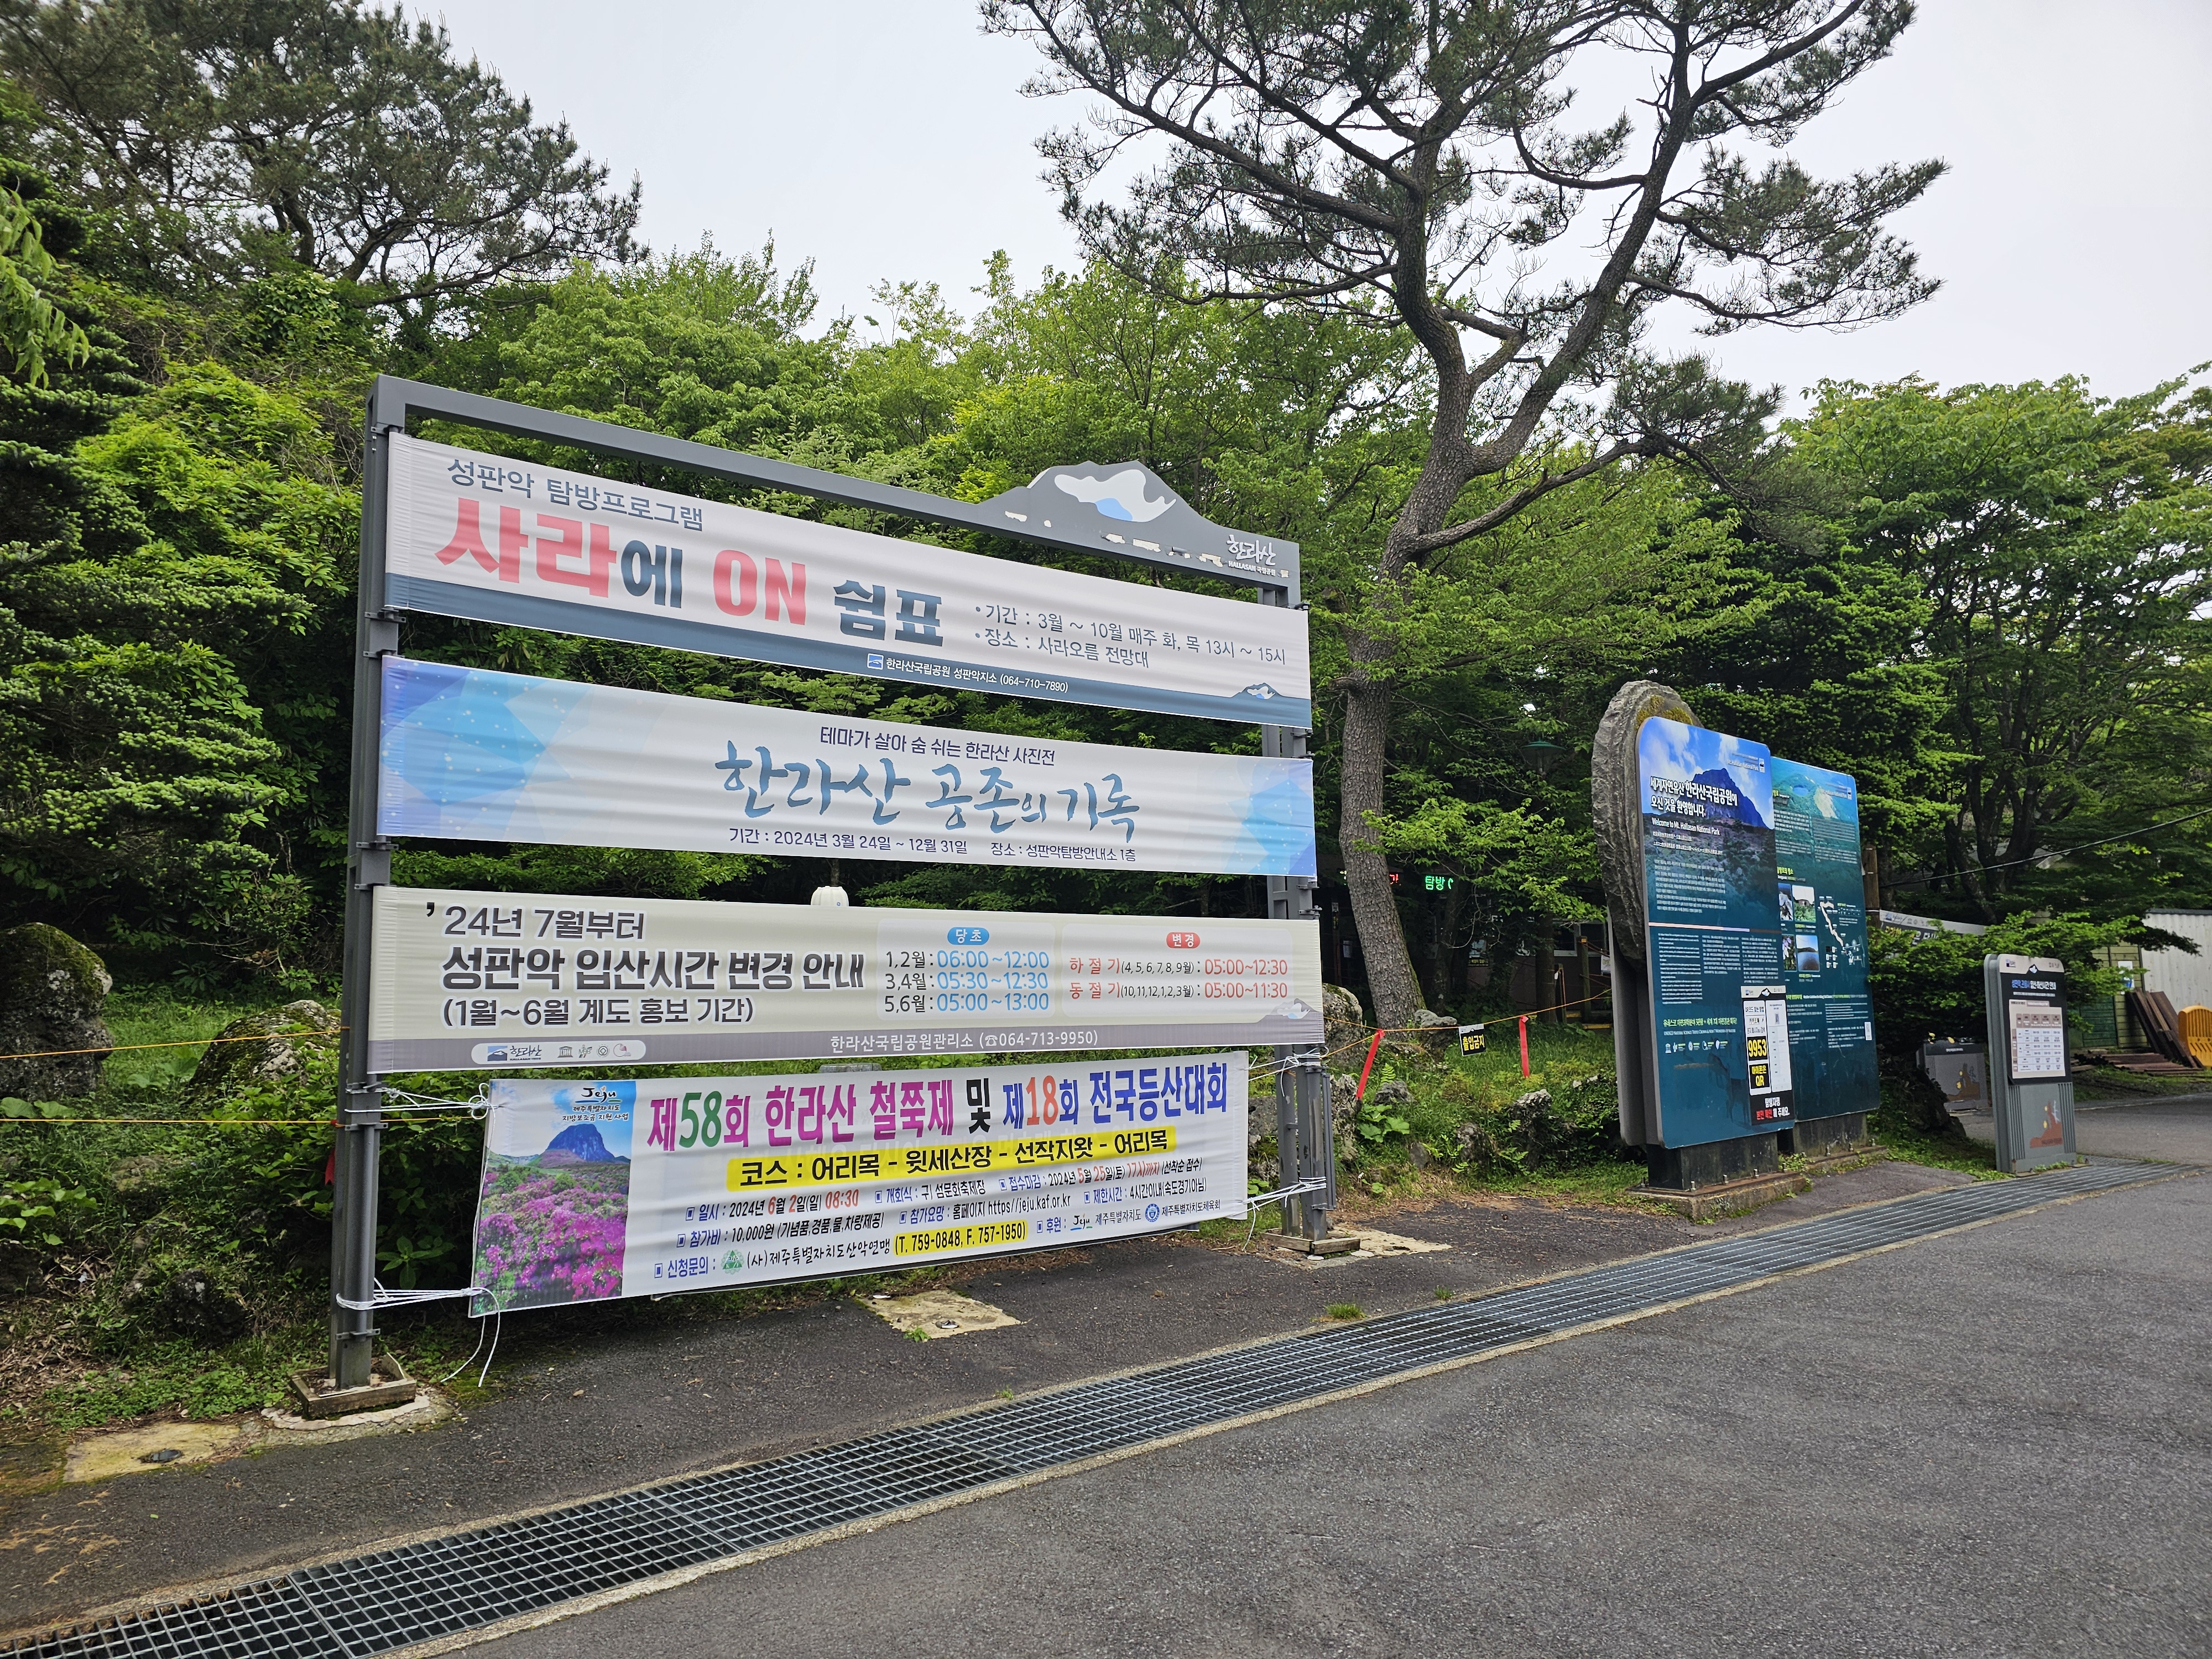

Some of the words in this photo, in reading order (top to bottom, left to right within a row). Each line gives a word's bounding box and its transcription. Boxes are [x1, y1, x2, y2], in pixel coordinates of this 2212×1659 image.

[447, 458, 535, 499] 성판악
[547, 478, 703, 532] 탐방프로그램
[1227, 534, 1276, 566] 한라산
[435, 497, 684, 609] 사라에
[713, 549, 806, 625] ON
[833, 580, 943, 647] 쉼표
[1228, 560, 1256, 572] HALLASAN
[985, 628, 1018, 648] 장소
[1038, 637, 1099, 661] 사라오름
[1105, 646, 1149, 668] 전망대
[986, 605, 1018, 625] 기간
[1039, 613, 1063, 633] 3월
[1091, 622, 1122, 641] 10월
[1129, 628, 1157, 646] 매주
[1162, 632, 1181, 651] 화,
[1186, 635, 1200, 653] 목
[1206, 639, 1234, 658] 13시
[1258, 647, 1285, 665] 15시
[886, 658, 951, 677] 한라산국립공원
[953, 667, 997, 683] 성판악지소
[999, 674, 1069, 693] (064-710-7890)
[821, 726, 870, 748] 테마가
[874, 732, 907, 752] 살아
[911, 737, 926, 754] 숨
[931, 738, 961, 758] 쉬는
[966, 742, 1010, 762] 한라산
[1013, 747, 1055, 766] 사진전
[715, 740, 911, 826] 한라산
[925, 763, 1047, 833] 공존의
[1057, 773, 1141, 843] 기록
[1650, 776, 1684, 795] 세계자연유산
[1684, 780, 1738, 806] 한라산국립공원에
[1651, 795, 1663, 810] 오신
[1664, 797, 1676, 813] 것을
[729, 828, 760, 846] 기간
[774, 831, 828, 847] 2024년
[832, 834, 855, 849] 3월
[859, 836, 891, 851] 24일
[909, 838, 937, 853] 12월
[941, 840, 967, 854] 31일
[1652, 817, 1669, 827] Welcome
[1669, 820, 1674, 828] to
[1697, 825, 1711, 834] National
[1711, 827, 1720, 836] Park
[991, 842, 1016, 856] 장소
[1026, 844, 1117, 860] 성판악탐방안내소
[1120, 849, 1135, 862] 1층
[535, 909, 644, 939] 7월부터
[442, 946, 565, 990] 성판악
[576, 950, 719, 990] 입산시간
[727, 951, 794, 990] 변경
[802, 953, 864, 990] 안내
[444, 999, 568, 1026] (1월~6월
[578, 999, 630, 1024] 계도
[640, 998, 688, 1024] 홍보
[697, 998, 753, 1022] 기간)
[831, 1032, 973, 1053] 한라산국립공원관리소
[1463, 1034, 1485, 1051] 출입금지
[1748, 1039, 1767, 1057] 9953
[581, 1087, 616, 1103] Jeju
[1755, 1075, 1765, 1087] QR
[647, 1091, 749, 1152] 제58회
[765, 1084, 857, 1147] 한라산
[870, 1079, 953, 1140] 철쭉제
[966, 1078, 992, 1135] 및
[1003, 1075, 1079, 1130] 제18회
[1089, 1062, 1227, 1124] 전국등산대회
[740, 1160, 787, 1186] 코스
[812, 1154, 879, 1181] 어리목
[906, 1145, 992, 1174] 윗세산장
[1014, 1137, 1093, 1165] 선작지왓
[1114, 1129, 1168, 1154] 어리목
[1008, 1175, 1041, 1192] 접수마감
[1048, 1171, 1076, 1186] 2024년
[1077, 1168, 1092, 1183] 5월
[1094, 1166, 1125, 1182] 25일(토)
[1127, 1161, 1160, 1178] 17시까지
[1161, 1159, 1185, 1175] (선착순
[1186, 1157, 1202, 1172] 접수)
[699, 1203, 720, 1222] 일시
[729, 1199, 765, 1218] 2024년
[768, 1196, 786, 1215] 6월
[789, 1194, 822, 1213] 2일(일)
[823, 1189, 860, 1211] 08:30
[886, 1186, 912, 1203] 개회식
[935, 1180, 985, 1199] 섬문화축제장
[1093, 1187, 1122, 1204] 제한시간
[1130, 1177, 1207, 1199] 4시간이내(속도경기아님)
[910, 1206, 945, 1224] 참가요망
[953, 1201, 985, 1220] 홈페이지
[1046, 1217, 1061, 1234] 후원
[1095, 1209, 1141, 1225] 제주특별자치도
[1161, 1199, 1220, 1217] 제주특별자치도체육회
[667, 1256, 708, 1279] 신청문의
[893, 1235, 907, 1256] (T.
[912, 1229, 963, 1251] 759-0848,
[967, 1228, 974, 1245] F.
[978, 1222, 1026, 1244] 757-1950)
[690, 1229, 721, 1248] 참가비
[732, 1223, 775, 1243] 10,000원
